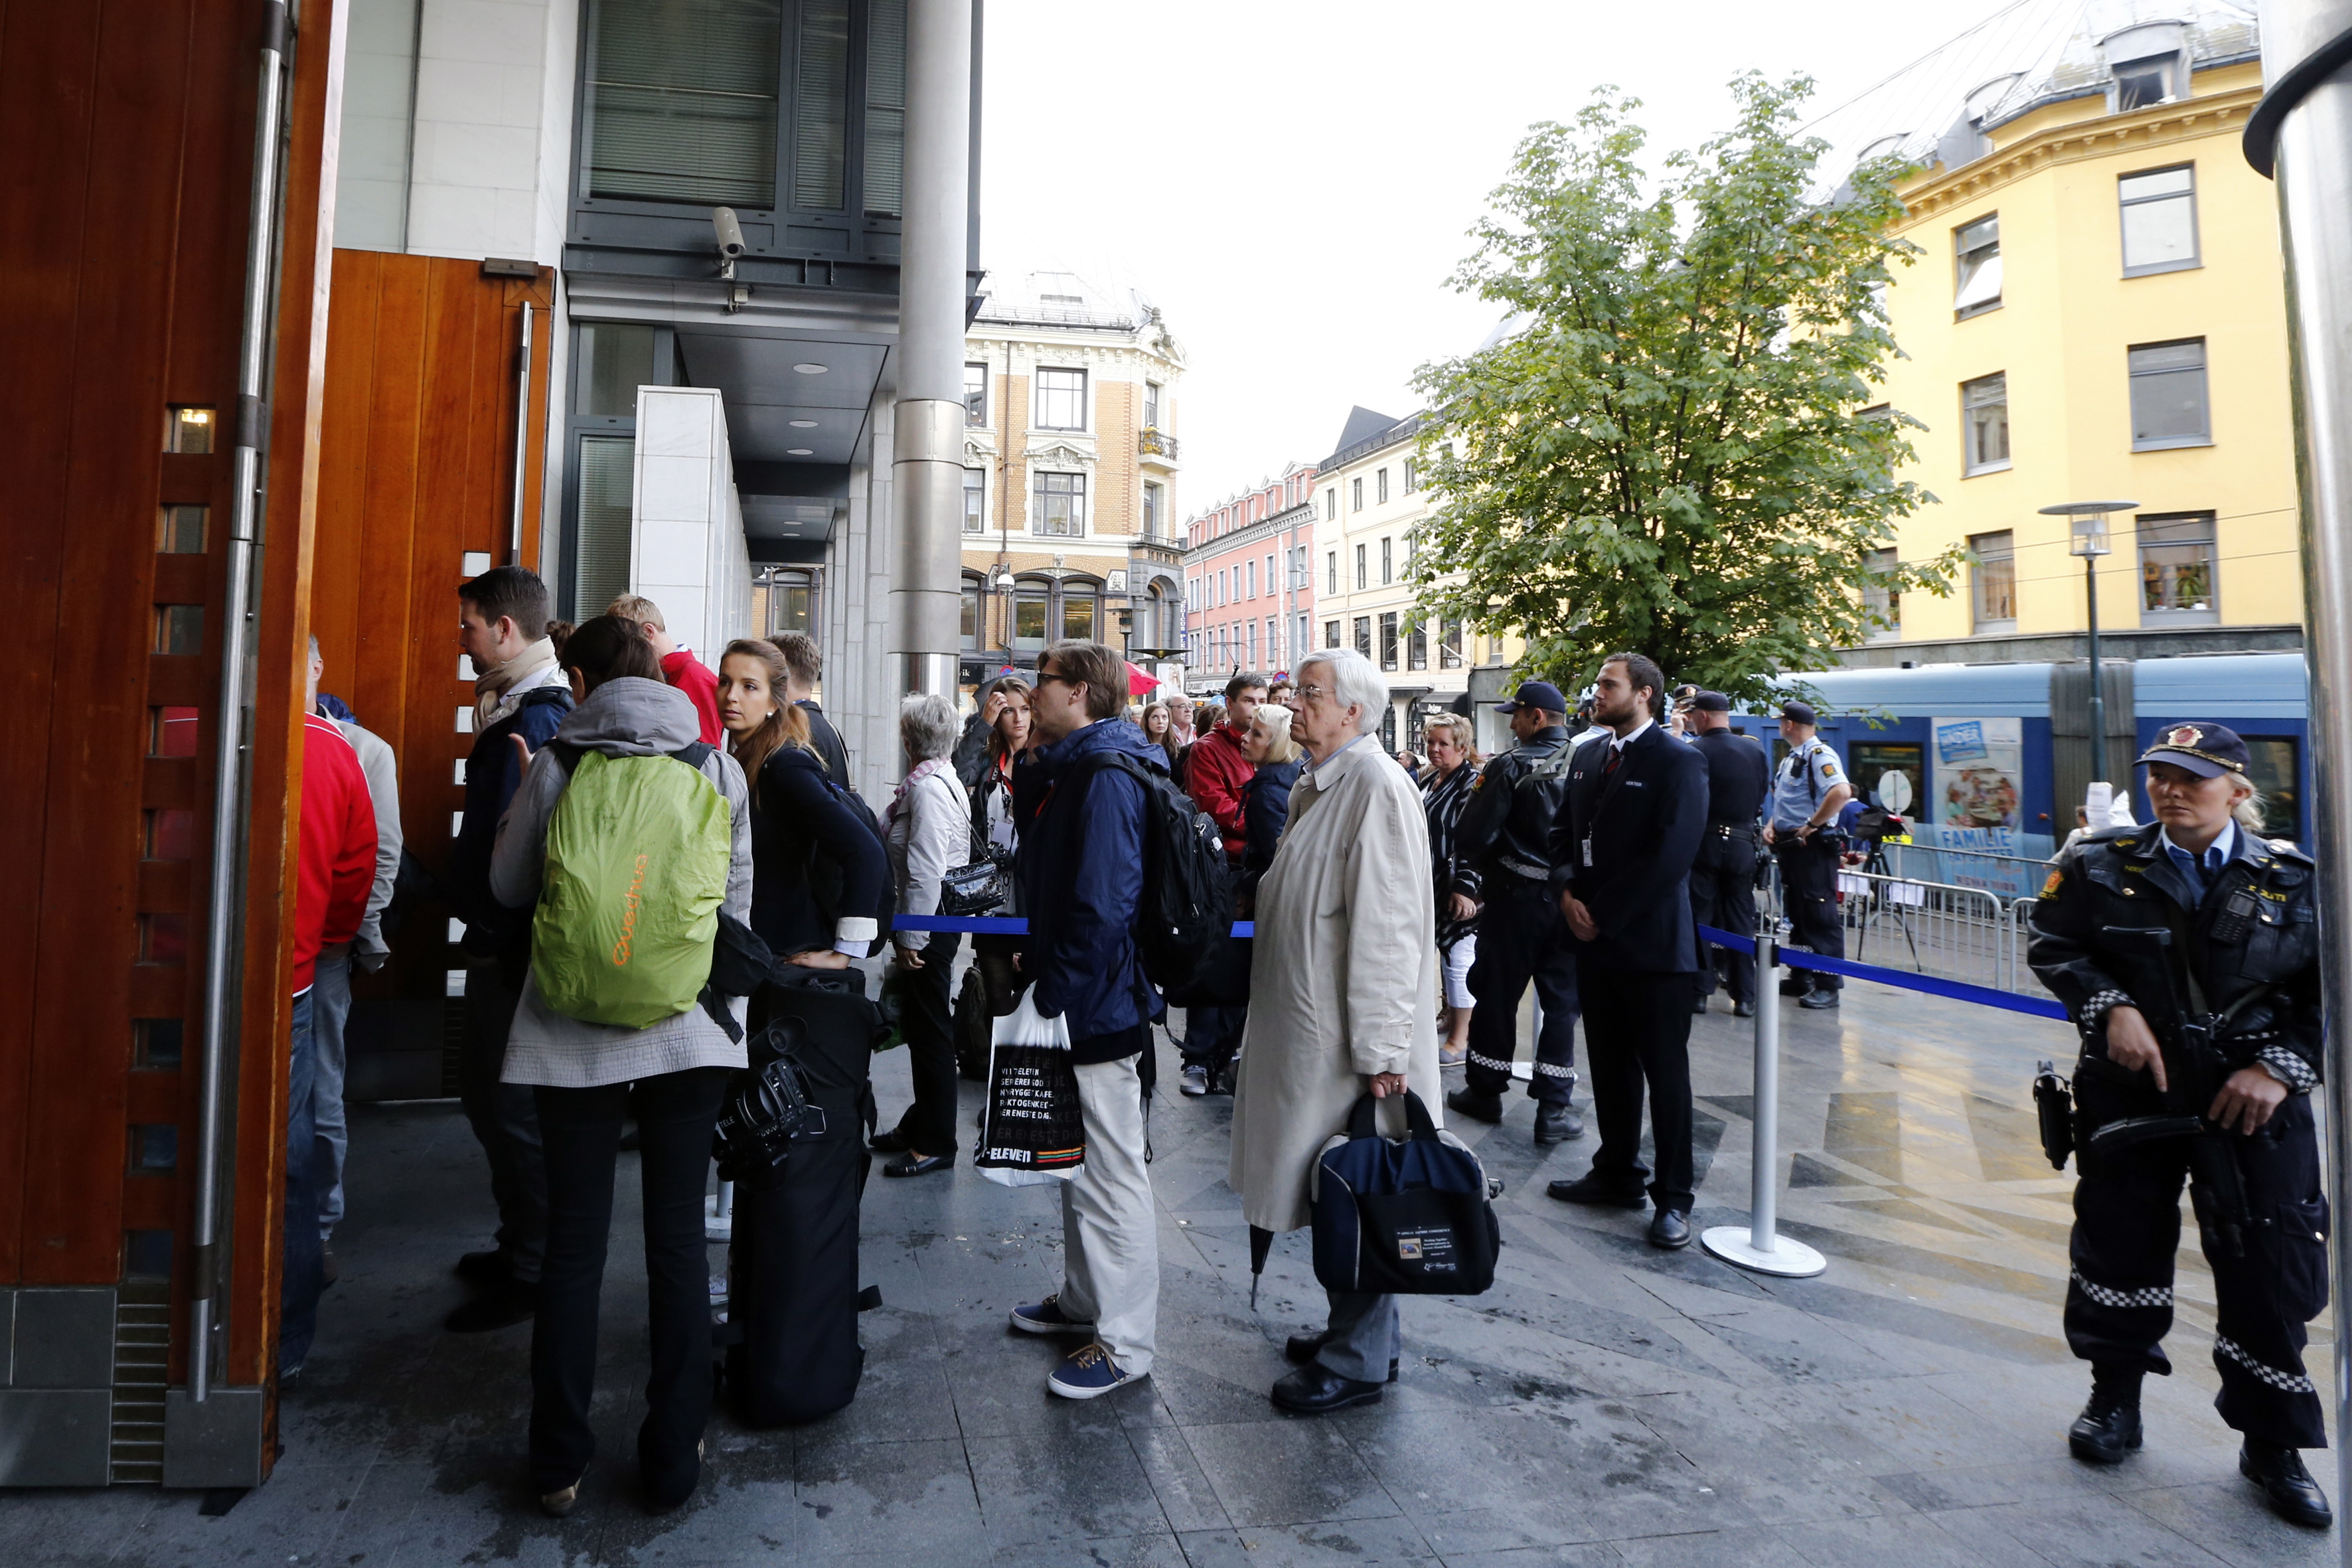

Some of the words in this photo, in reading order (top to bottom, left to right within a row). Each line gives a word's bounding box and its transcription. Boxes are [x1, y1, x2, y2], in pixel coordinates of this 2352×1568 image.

[1941, 826, 2012, 849] FAMILIE
[613, 854, 649, 966] Quechua
[720, 1116, 735, 1129] TELE
